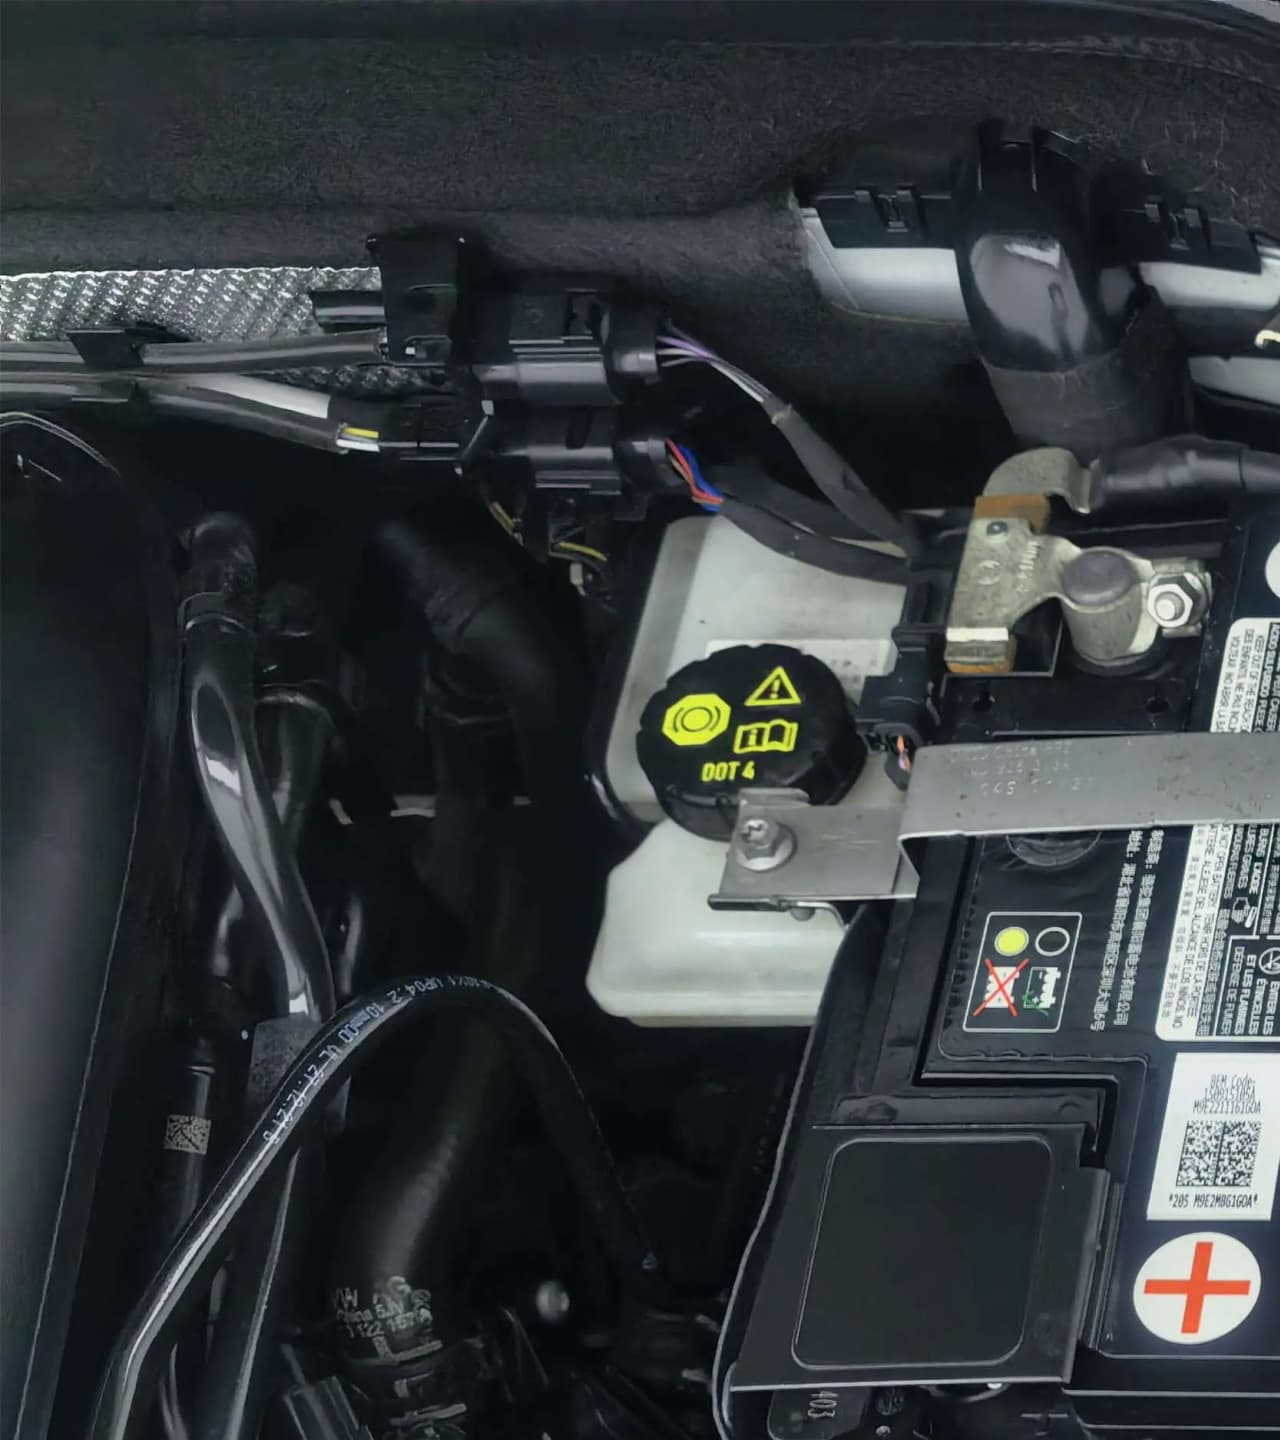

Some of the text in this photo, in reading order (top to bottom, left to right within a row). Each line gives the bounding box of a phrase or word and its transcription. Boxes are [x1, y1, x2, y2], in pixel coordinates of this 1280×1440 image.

[701, 760, 755, 782] DOT 4
[1245, 954, 1256, 967] ET
